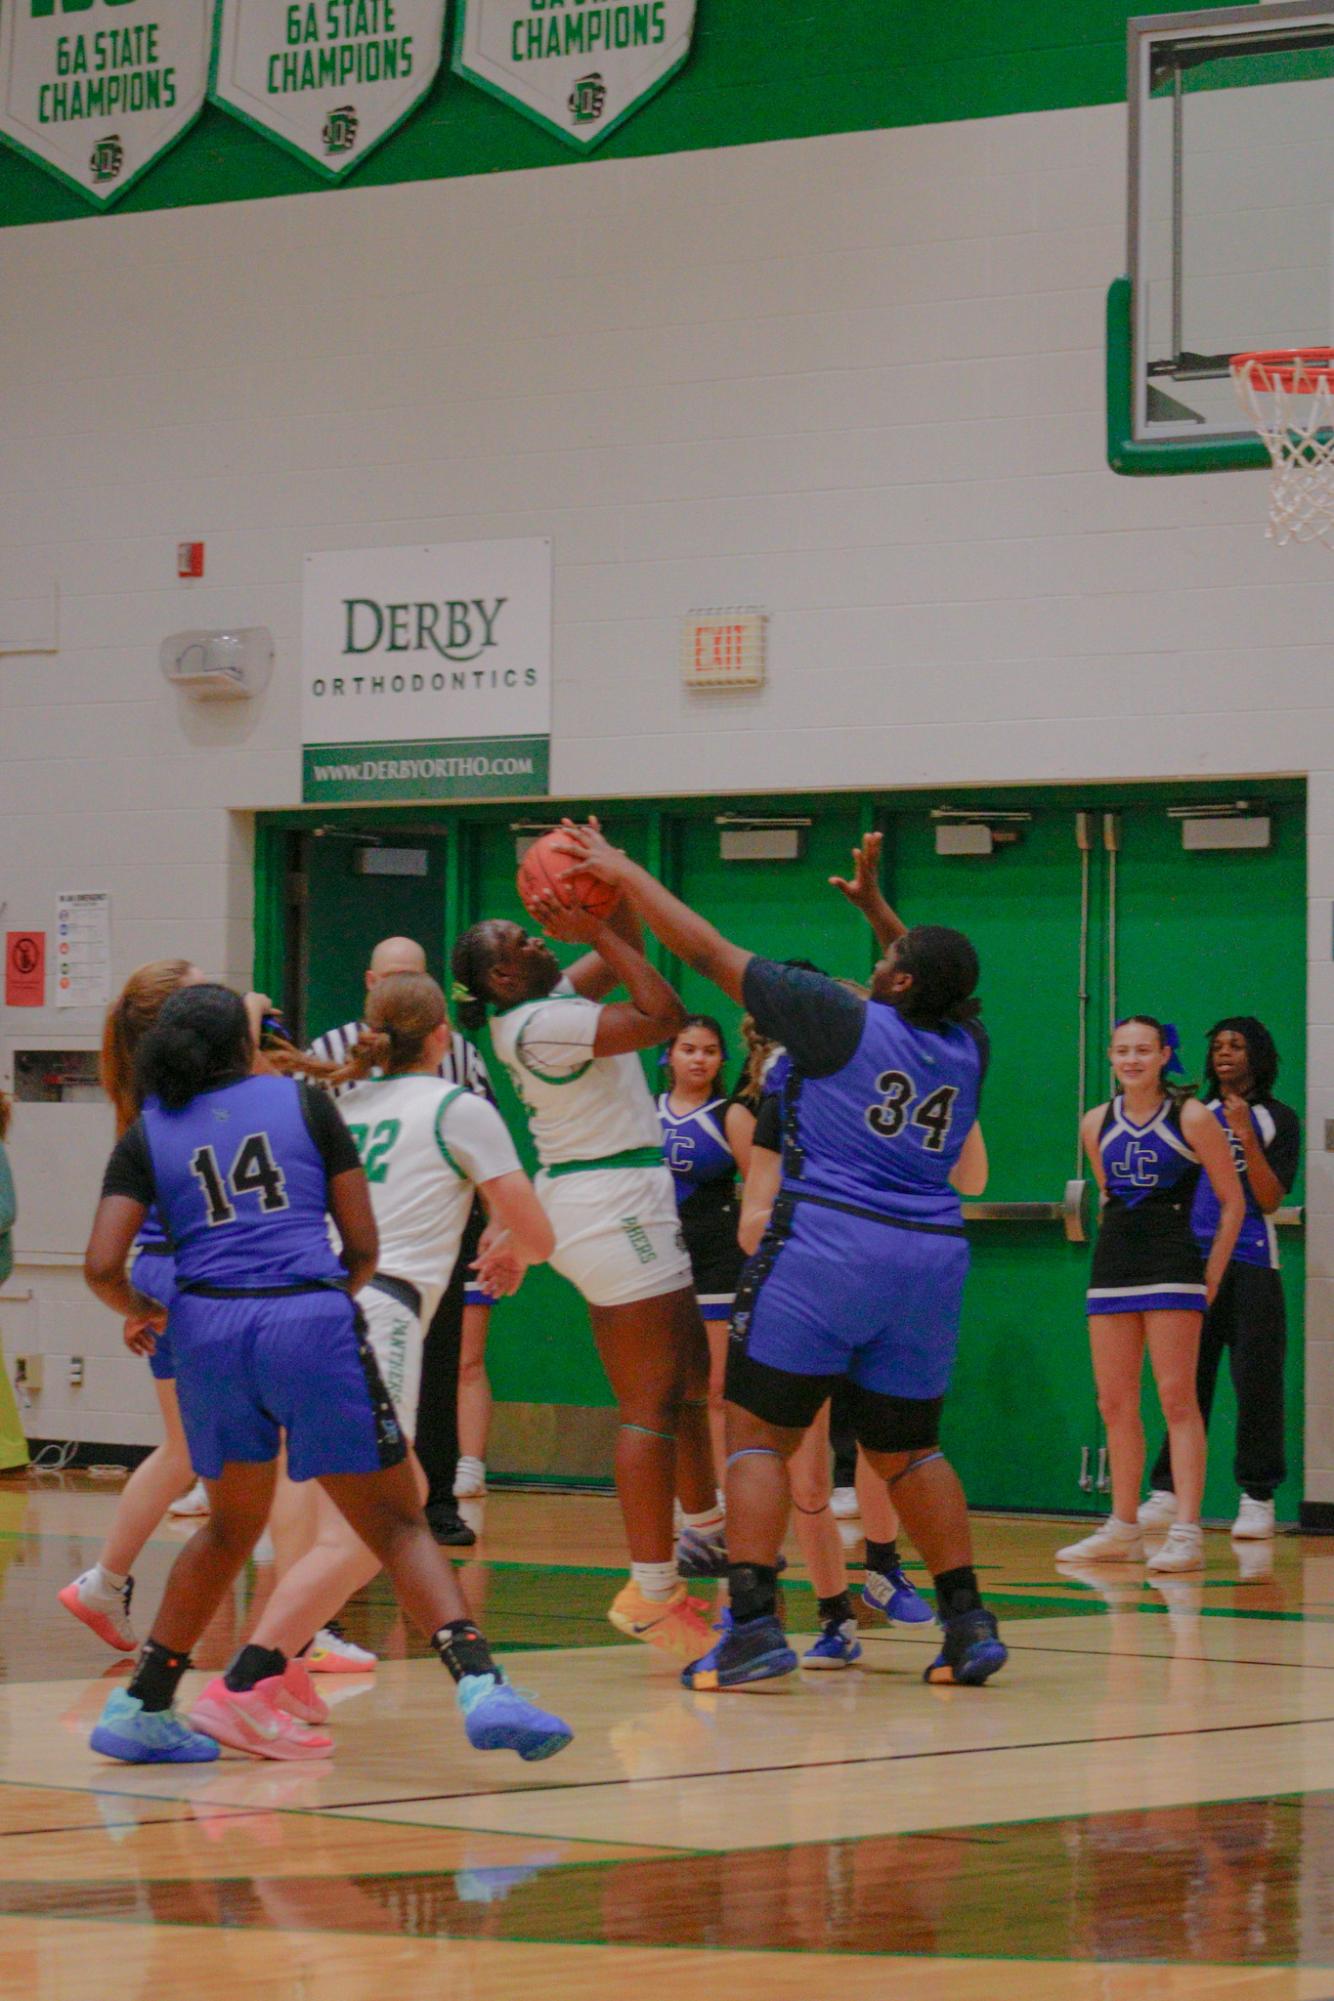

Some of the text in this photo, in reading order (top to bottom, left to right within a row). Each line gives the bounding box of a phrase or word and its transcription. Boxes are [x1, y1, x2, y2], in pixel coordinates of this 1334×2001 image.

[56, 23, 159, 76] 6A STATE
[286, 0, 396, 46] 6A STATE
[511, 1, 665, 62] CHAMPIONS
[267, 36, 413, 94] CHAMPIONS
[38, 67, 177, 124] CHAMPIONS
[341, 597, 508, 662] DERBY
[694, 624, 745, 674] EXIT
[312, 667, 538, 696] ORTHODONTICS
[865, 1070, 960, 1153] 34
[189, 1132, 290, 1227] 14
[1111, 1141, 1158, 1188] JC
